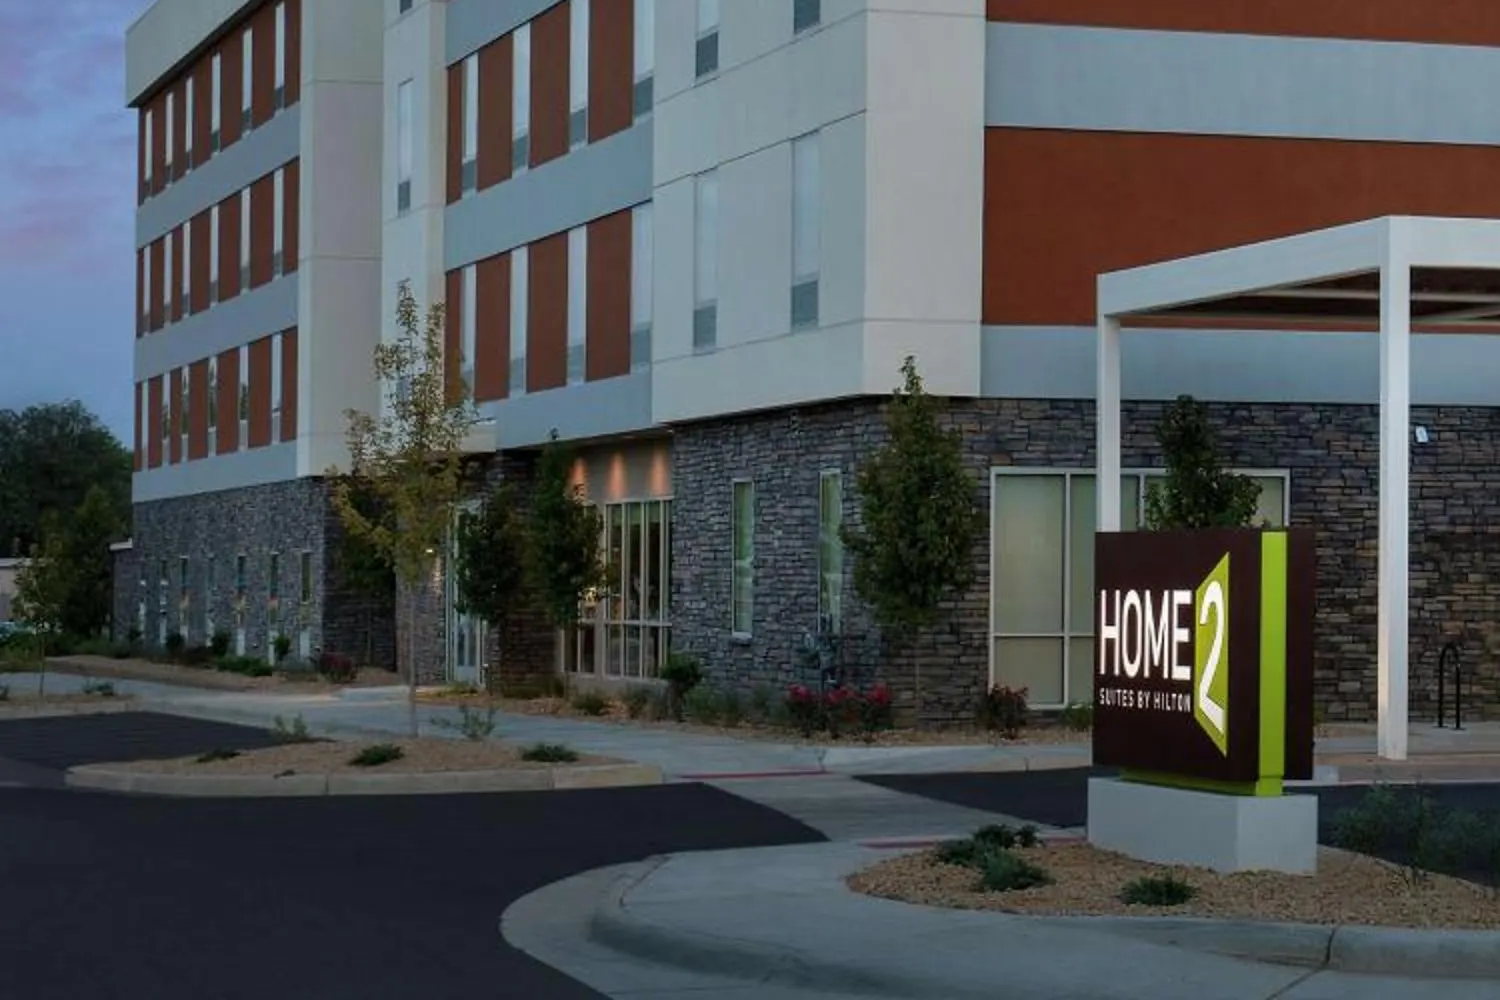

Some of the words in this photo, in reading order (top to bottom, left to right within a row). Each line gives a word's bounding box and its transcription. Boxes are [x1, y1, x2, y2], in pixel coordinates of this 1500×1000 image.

[1099, 687, 1134, 707] SUITES
[1137, 690, 1151, 709] BY
[1153, 691, 1191, 713] HILTON
